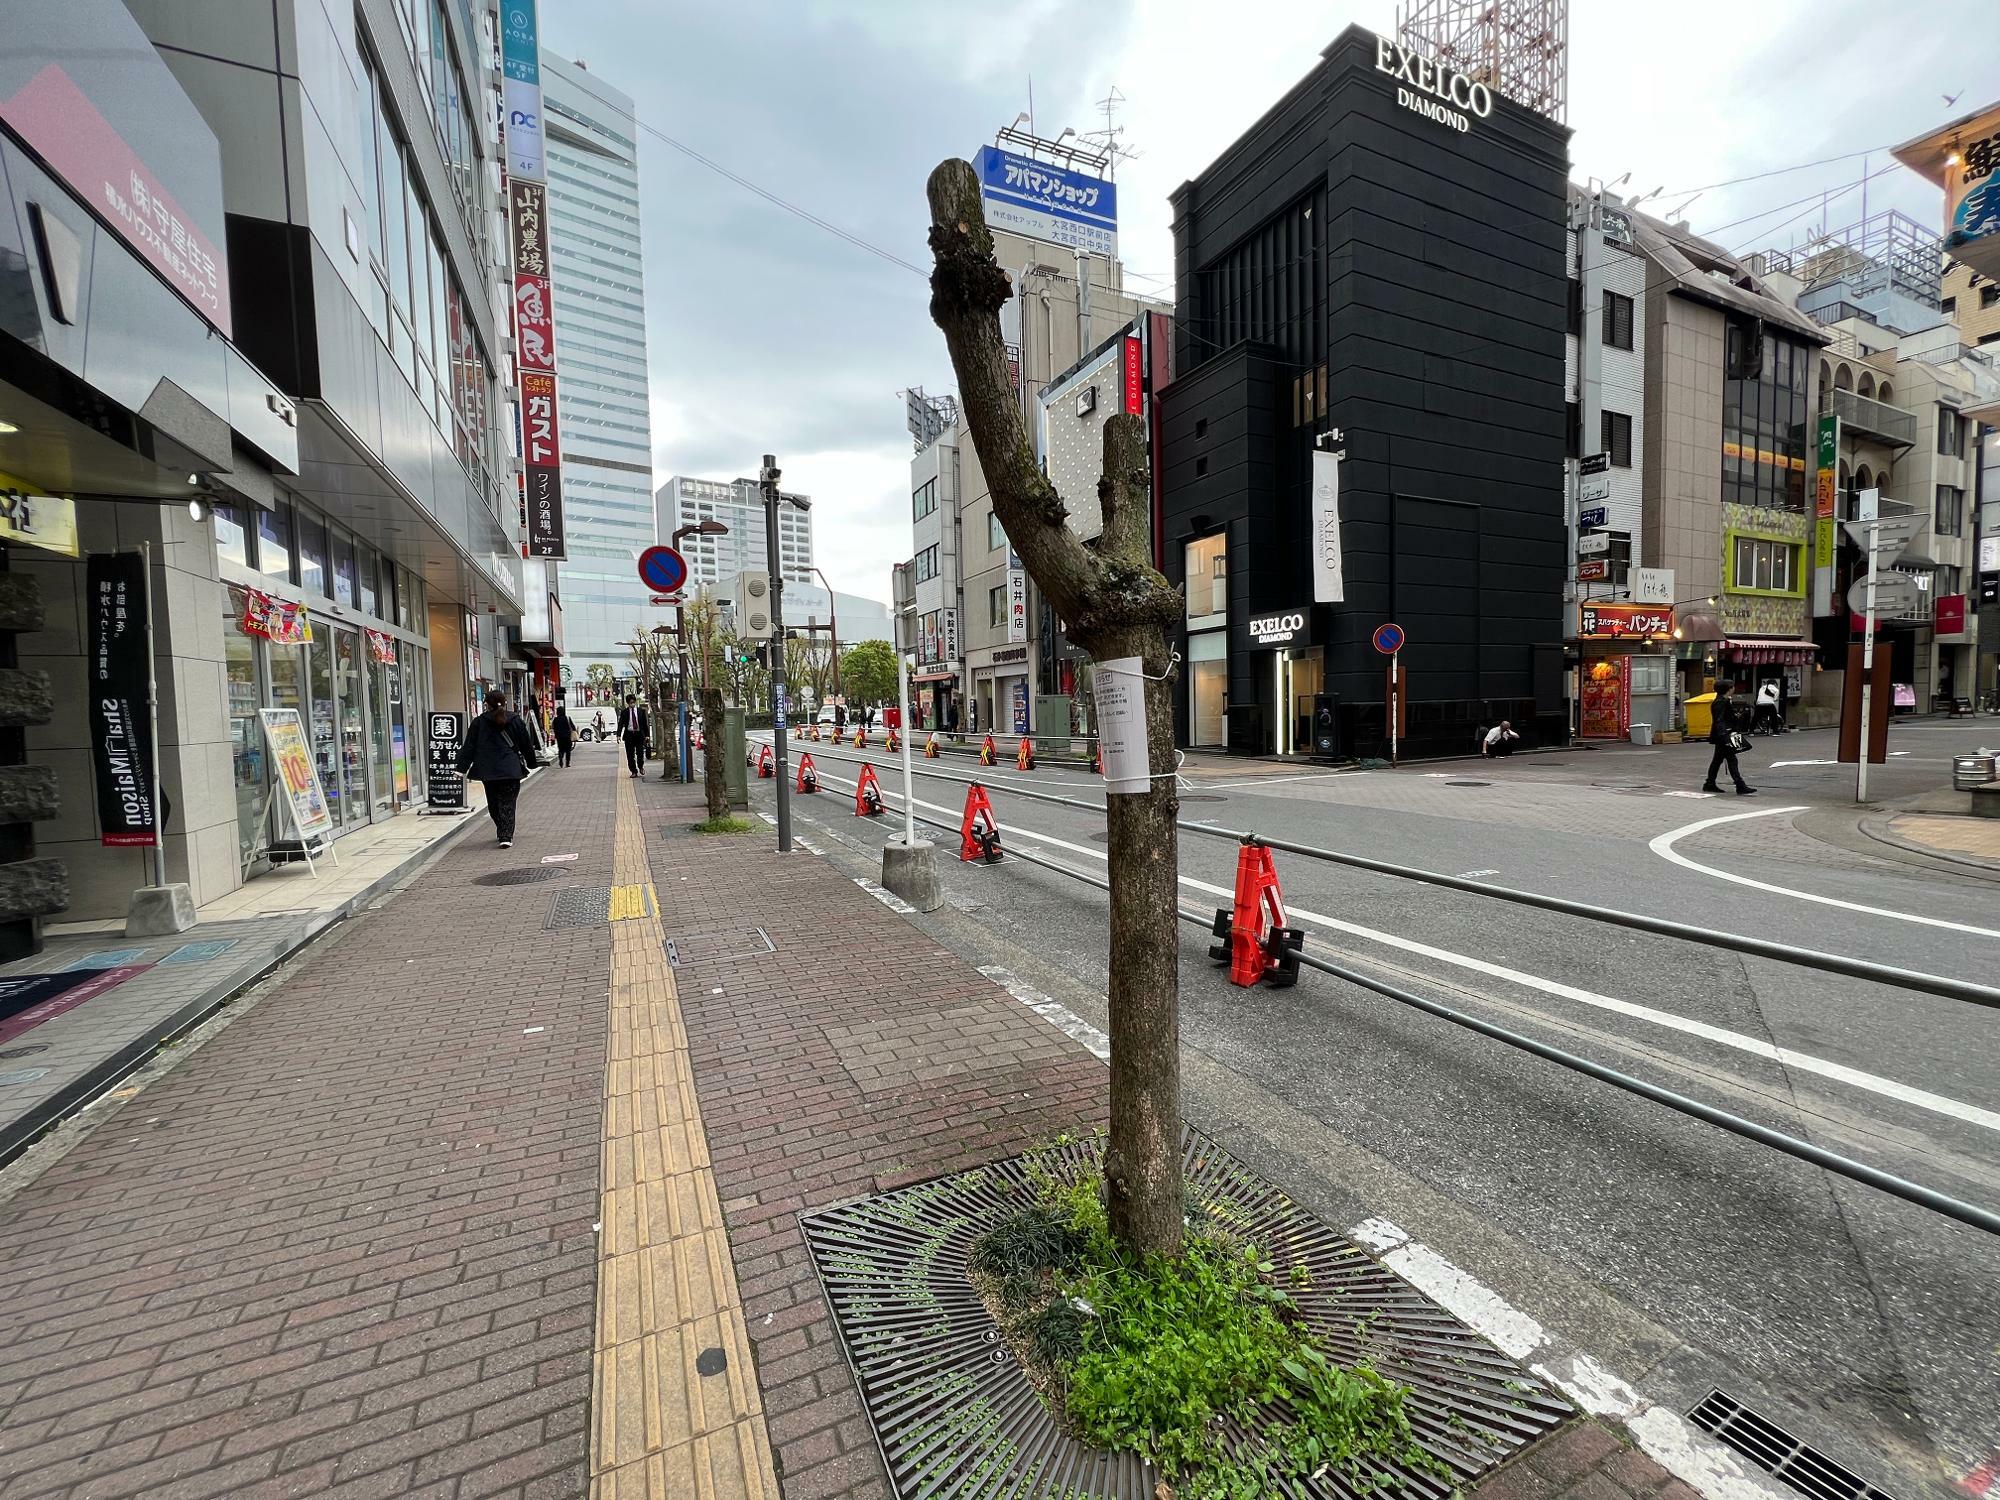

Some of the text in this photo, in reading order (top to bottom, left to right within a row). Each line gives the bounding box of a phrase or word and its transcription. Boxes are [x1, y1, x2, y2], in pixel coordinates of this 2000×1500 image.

[1375, 35, 1492, 119] EXELCO
[1397, 87, 1469, 133] DIAMOND
[520, 161, 533, 171] 4F
[1004, 164, 1099, 207] アパマンショップ
[516, 187, 545, 275] 山内農場
[993, 210, 1044, 230] 株式会社アップル
[1051, 218, 1112, 243] 大宮西口駅前店
[1051, 230, 1112, 254] 大宮西口中央店
[537, 279, 551, 290] 3F
[516, 281, 553, 367] 魚民
[526, 385, 552, 395] レストラン
[528, 396, 552, 463] ガスト
[537, 472, 552, 537] ワインの酒場。
[541, 546, 553, 555] 2F
[1323, 509, 1336, 570] EXELCO
[1013, 577, 1024, 629] 石井肉店
[1249, 613, 1304, 636] EXELCO
[1258, 631, 1293, 644] DIAMOND
[435, 718, 453, 736] 薬
[429, 741, 462, 751] 処方せん
